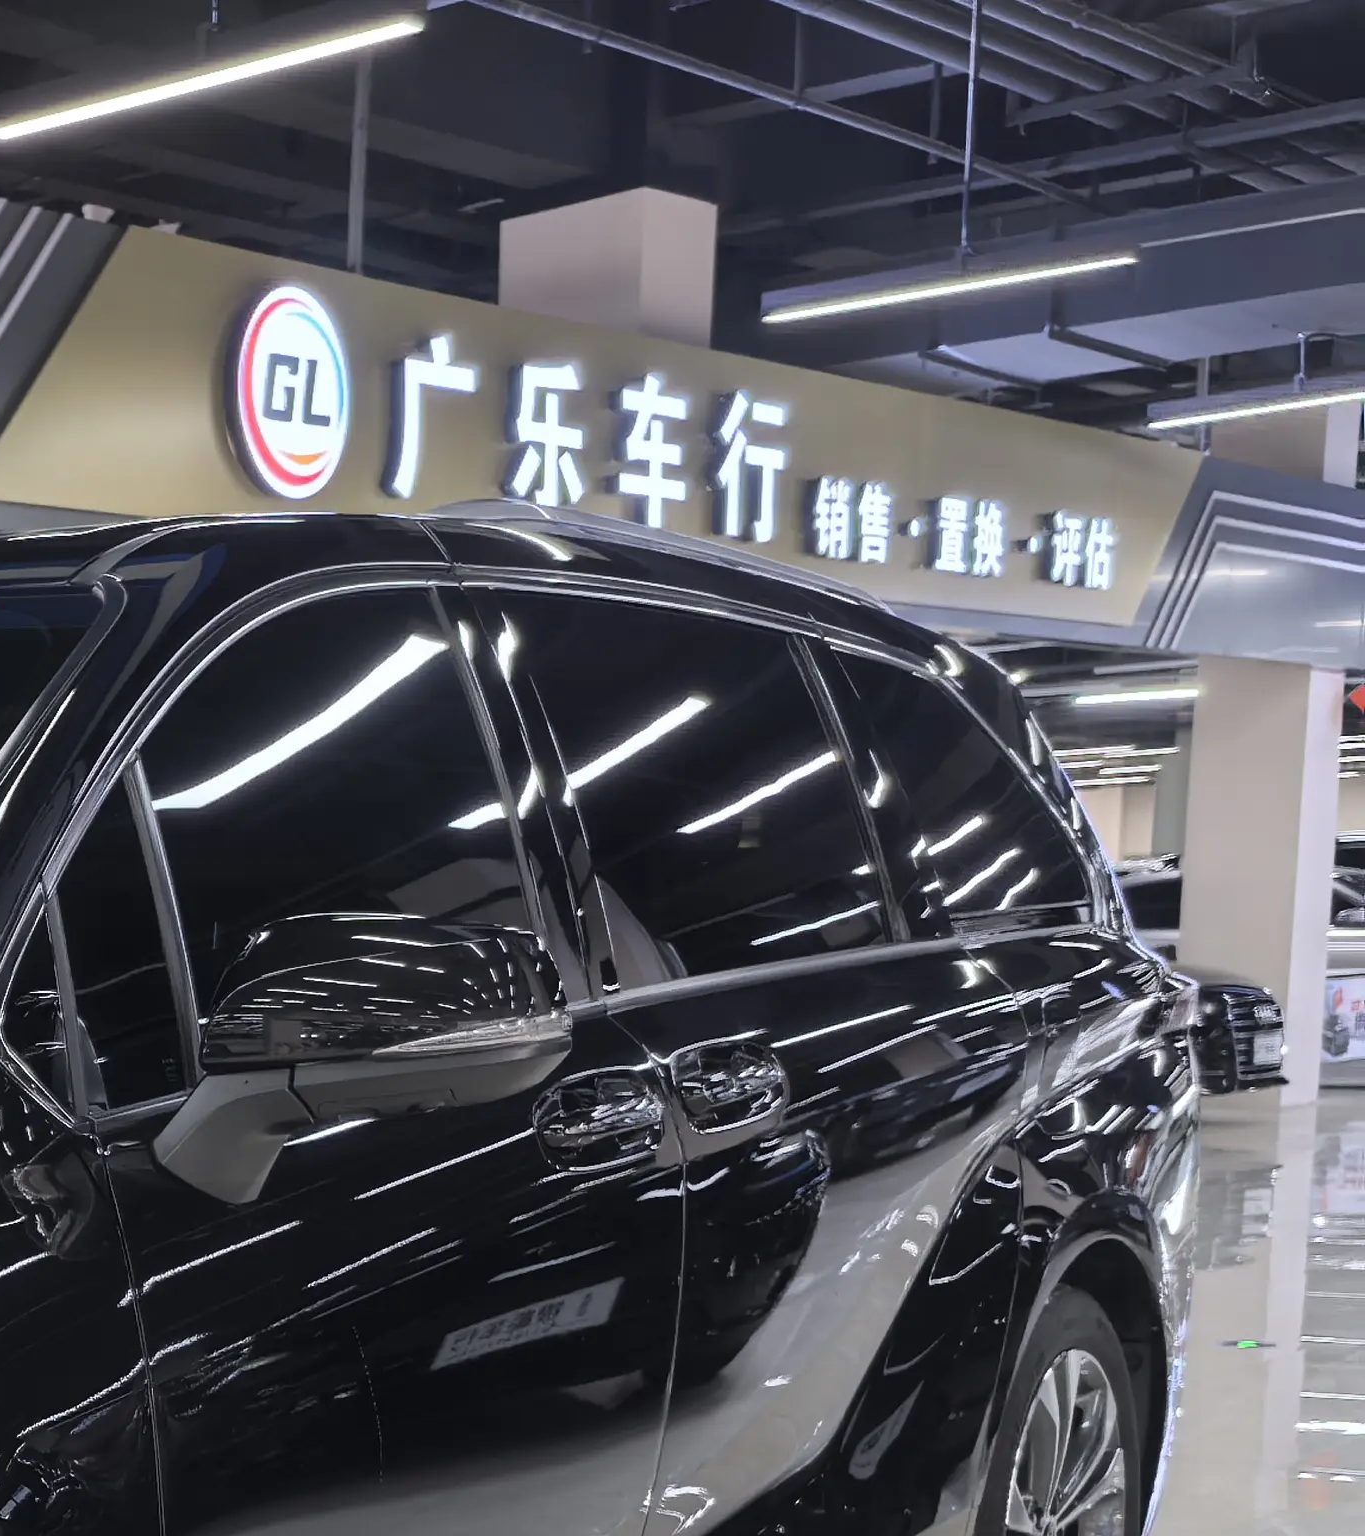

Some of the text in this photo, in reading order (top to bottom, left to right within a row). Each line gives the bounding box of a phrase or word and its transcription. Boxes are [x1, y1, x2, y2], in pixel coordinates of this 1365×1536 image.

[263, 353, 331, 428] GL
[391, 335, 787, 543] 广乐车行
